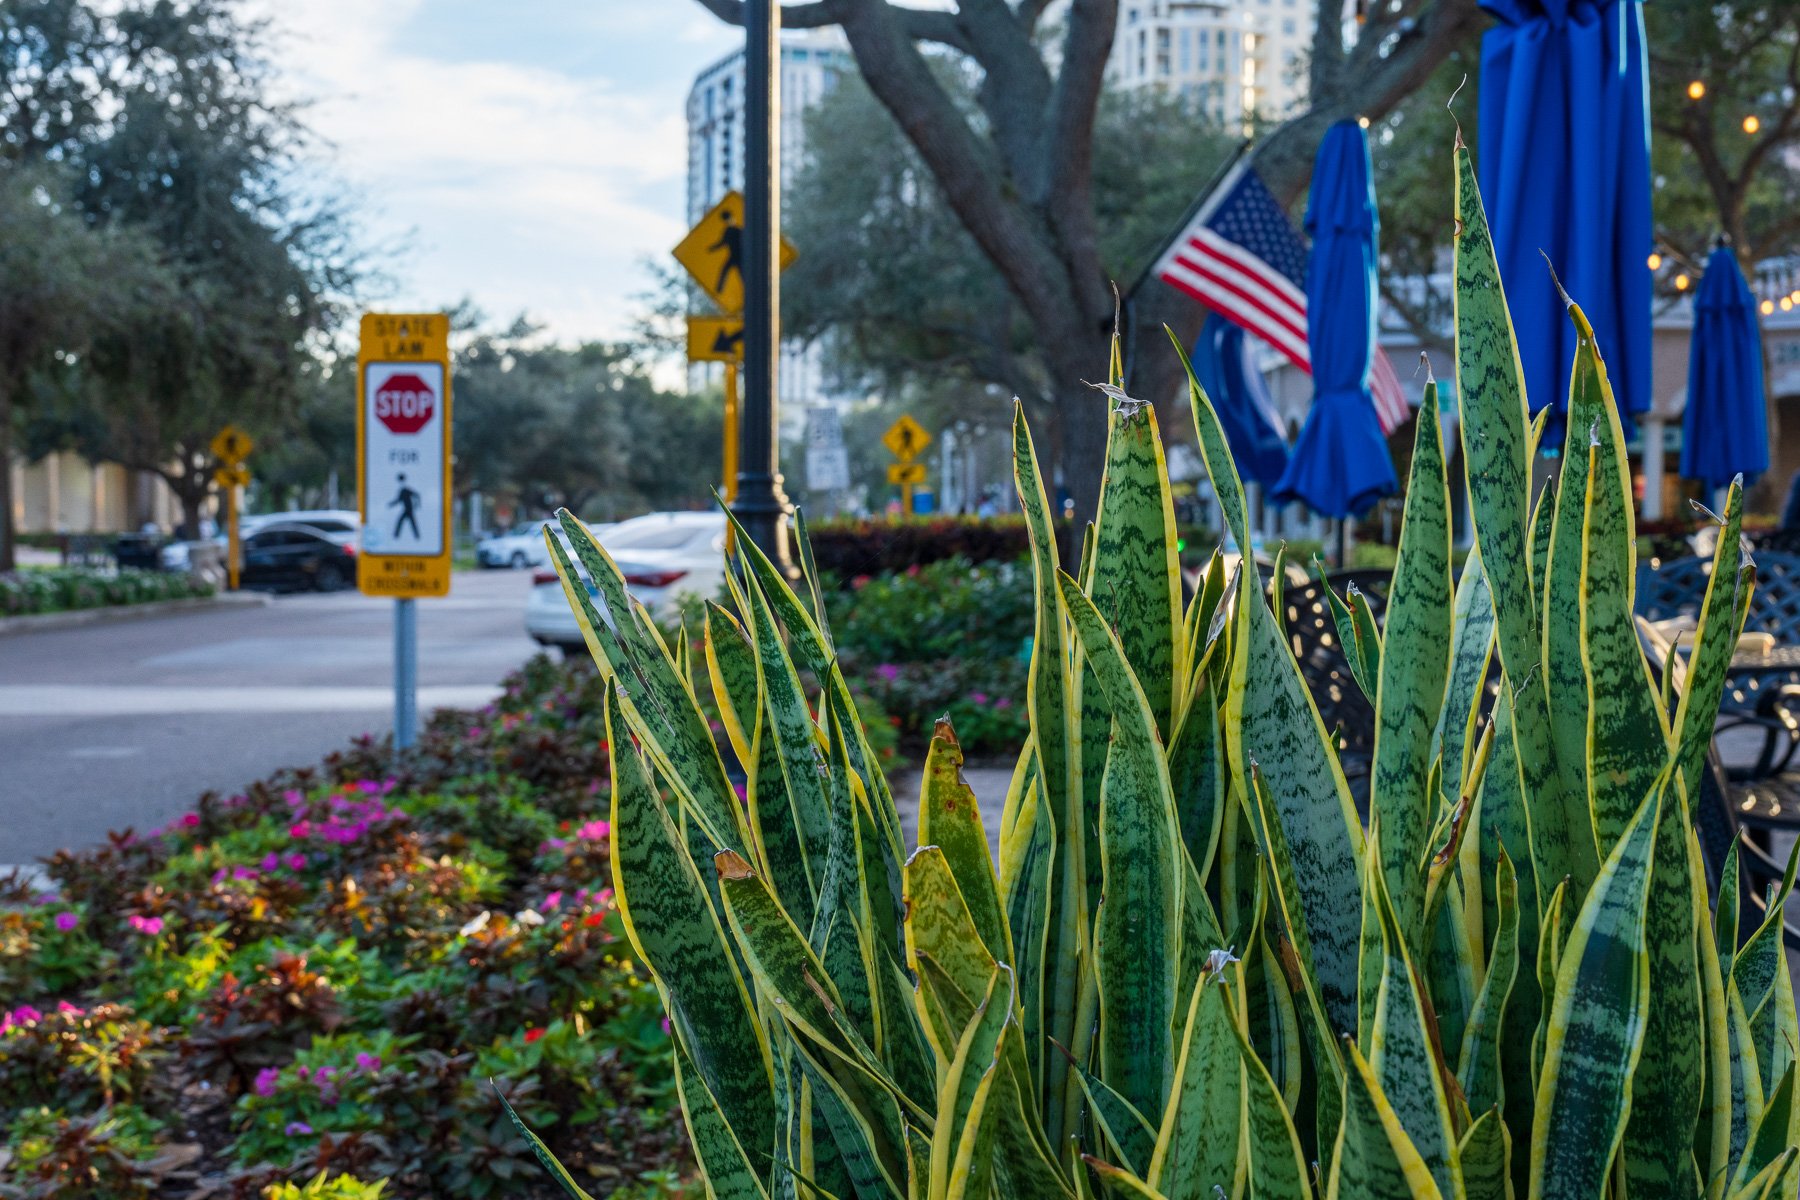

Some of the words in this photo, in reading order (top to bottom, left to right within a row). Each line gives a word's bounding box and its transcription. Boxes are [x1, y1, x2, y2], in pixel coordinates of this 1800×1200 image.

[375, 317, 433, 338] STATE
[384, 340, 424, 359] LAW
[376, 390, 434, 418] STOP
[389, 448, 420, 464] FOR
